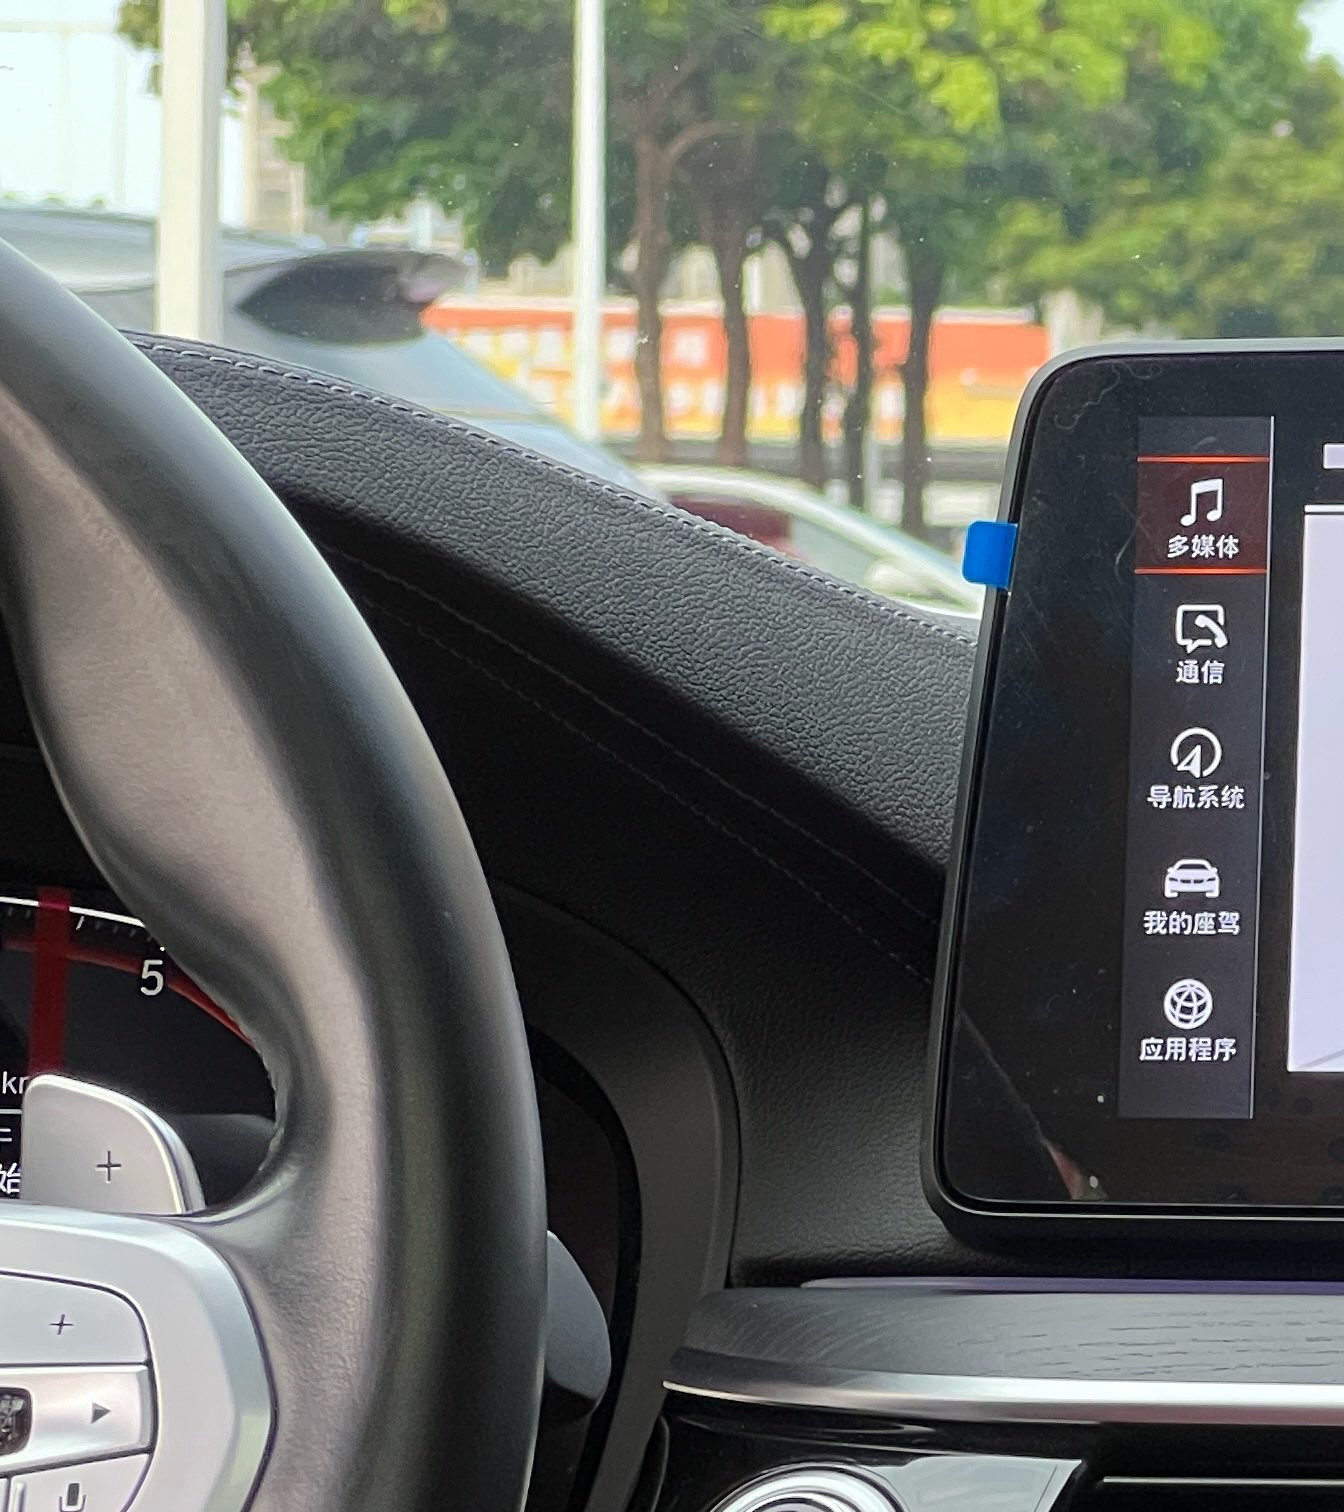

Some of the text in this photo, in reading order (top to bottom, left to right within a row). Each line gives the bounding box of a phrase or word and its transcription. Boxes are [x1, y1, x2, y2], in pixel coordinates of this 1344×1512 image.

[1167, 534, 1239, 559] 多媒体
[1175, 659, 1225, 685] 通信
[1146, 784, 1245, 810] 导航系统
[1143, 910, 1240, 937] 我的座驾
[140, 959, 164, 996] 5
[1139, 1036, 1237, 1062] 应用程序
